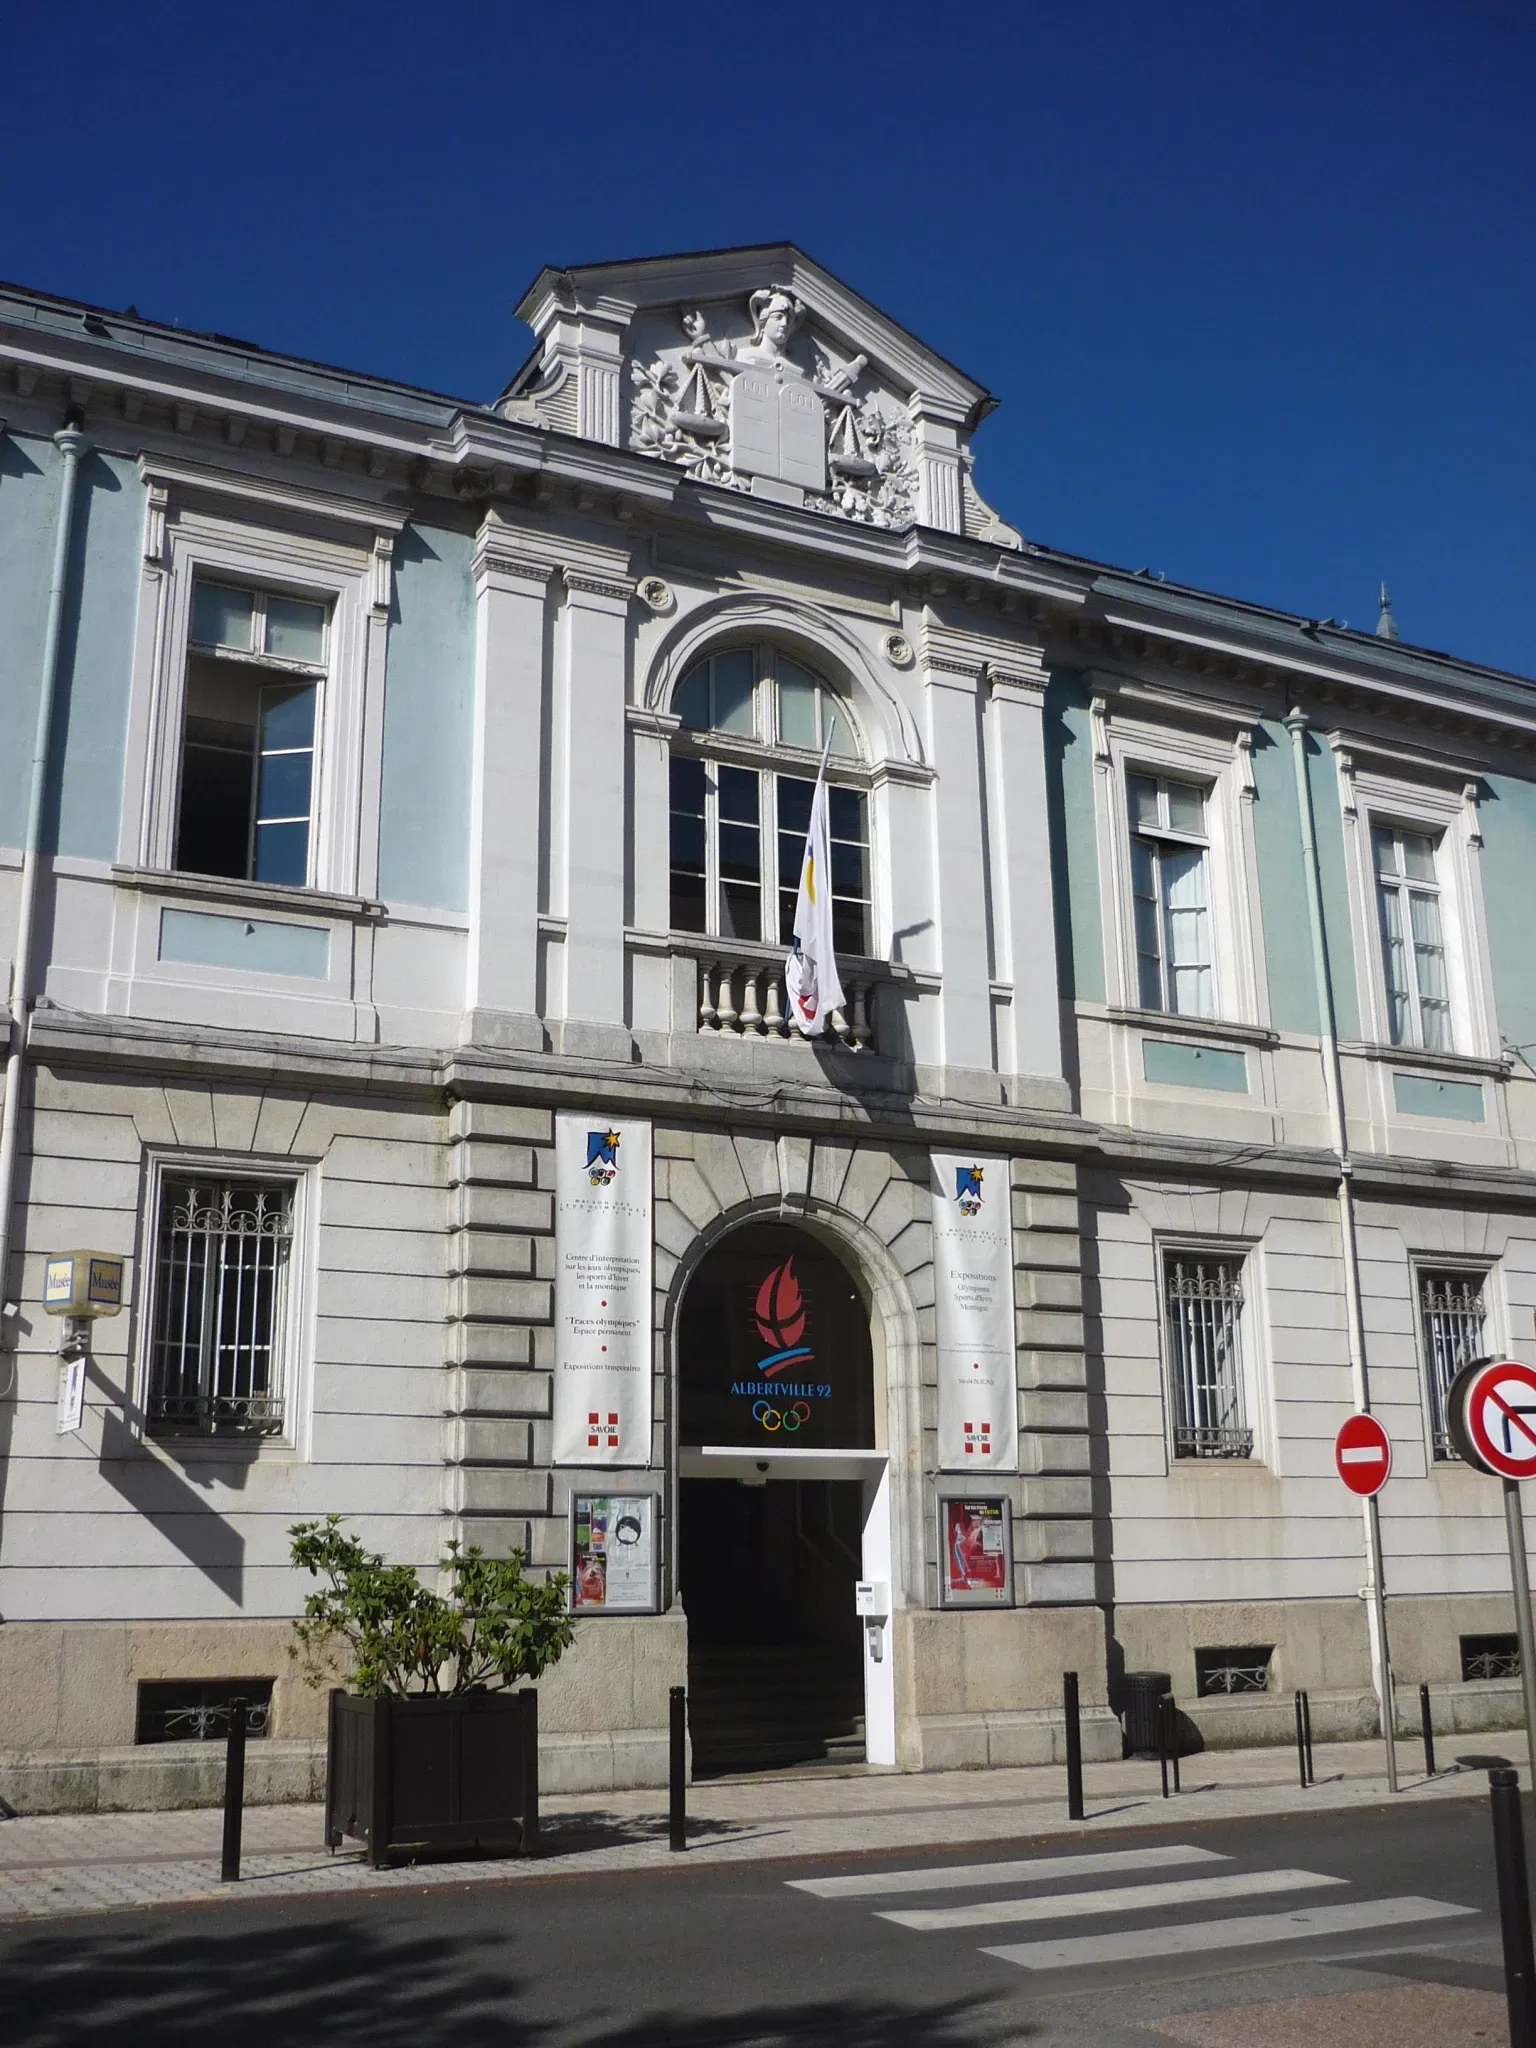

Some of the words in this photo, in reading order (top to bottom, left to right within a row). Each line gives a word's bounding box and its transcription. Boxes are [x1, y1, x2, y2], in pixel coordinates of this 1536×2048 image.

[742, 378, 769, 397] LOI
[788, 391, 814, 410] LOI
[565, 1253, 589, 1261] Centre
[577, 1262, 586, 1270] les
[587, 1264, 602, 1273] jeux
[603, 1264, 641, 1274] olympiques,
[48, 1273, 71, 1289] Musée
[92, 1271, 120, 1291] Musée
[576, 1272, 586, 1280] les
[586, 1273, 607, 1282] sports
[607, 1273, 629, 1282] d'hiver
[950, 1270, 997, 1282] Expositions
[586, 1282, 594, 1290] la
[573, 1326, 596, 1335] Espace
[563, 1361, 604, 1371] Expositions
[604, 1363, 641, 1372] temporaires
[731, 1382, 815, 1397] ALBERTVILLE
[816, 1383, 832, 1397] 92
[590, 1425, 617, 1434] SAVOIE
[966, 1434, 989, 1442] SAVOIE
